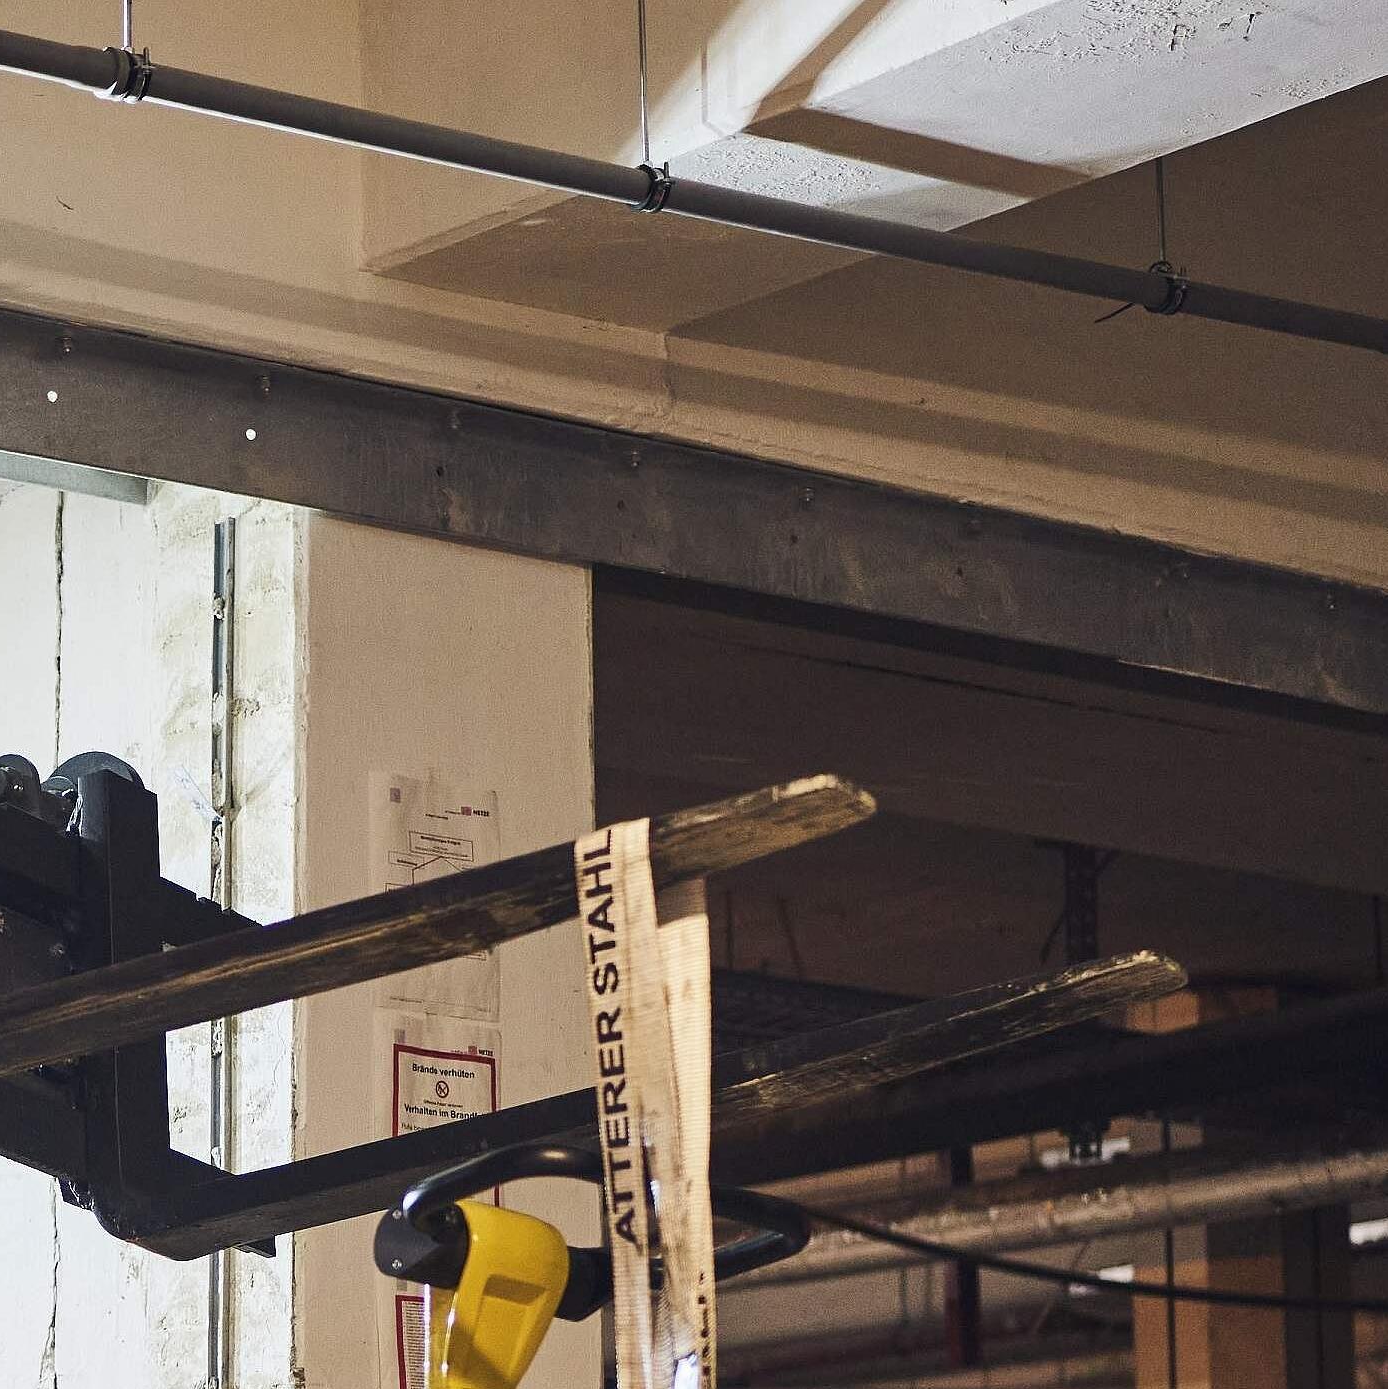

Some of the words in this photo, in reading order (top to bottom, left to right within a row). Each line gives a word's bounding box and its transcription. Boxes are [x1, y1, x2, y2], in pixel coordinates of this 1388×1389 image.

[582, 829, 620, 996] STAHL
[404, 1103, 438, 1117] Verhalten
[412, 1063, 438, 1075] Brände
[439, 1068, 475, 1079] verhüten
[595, 1006, 641, 1249] ATTERER
